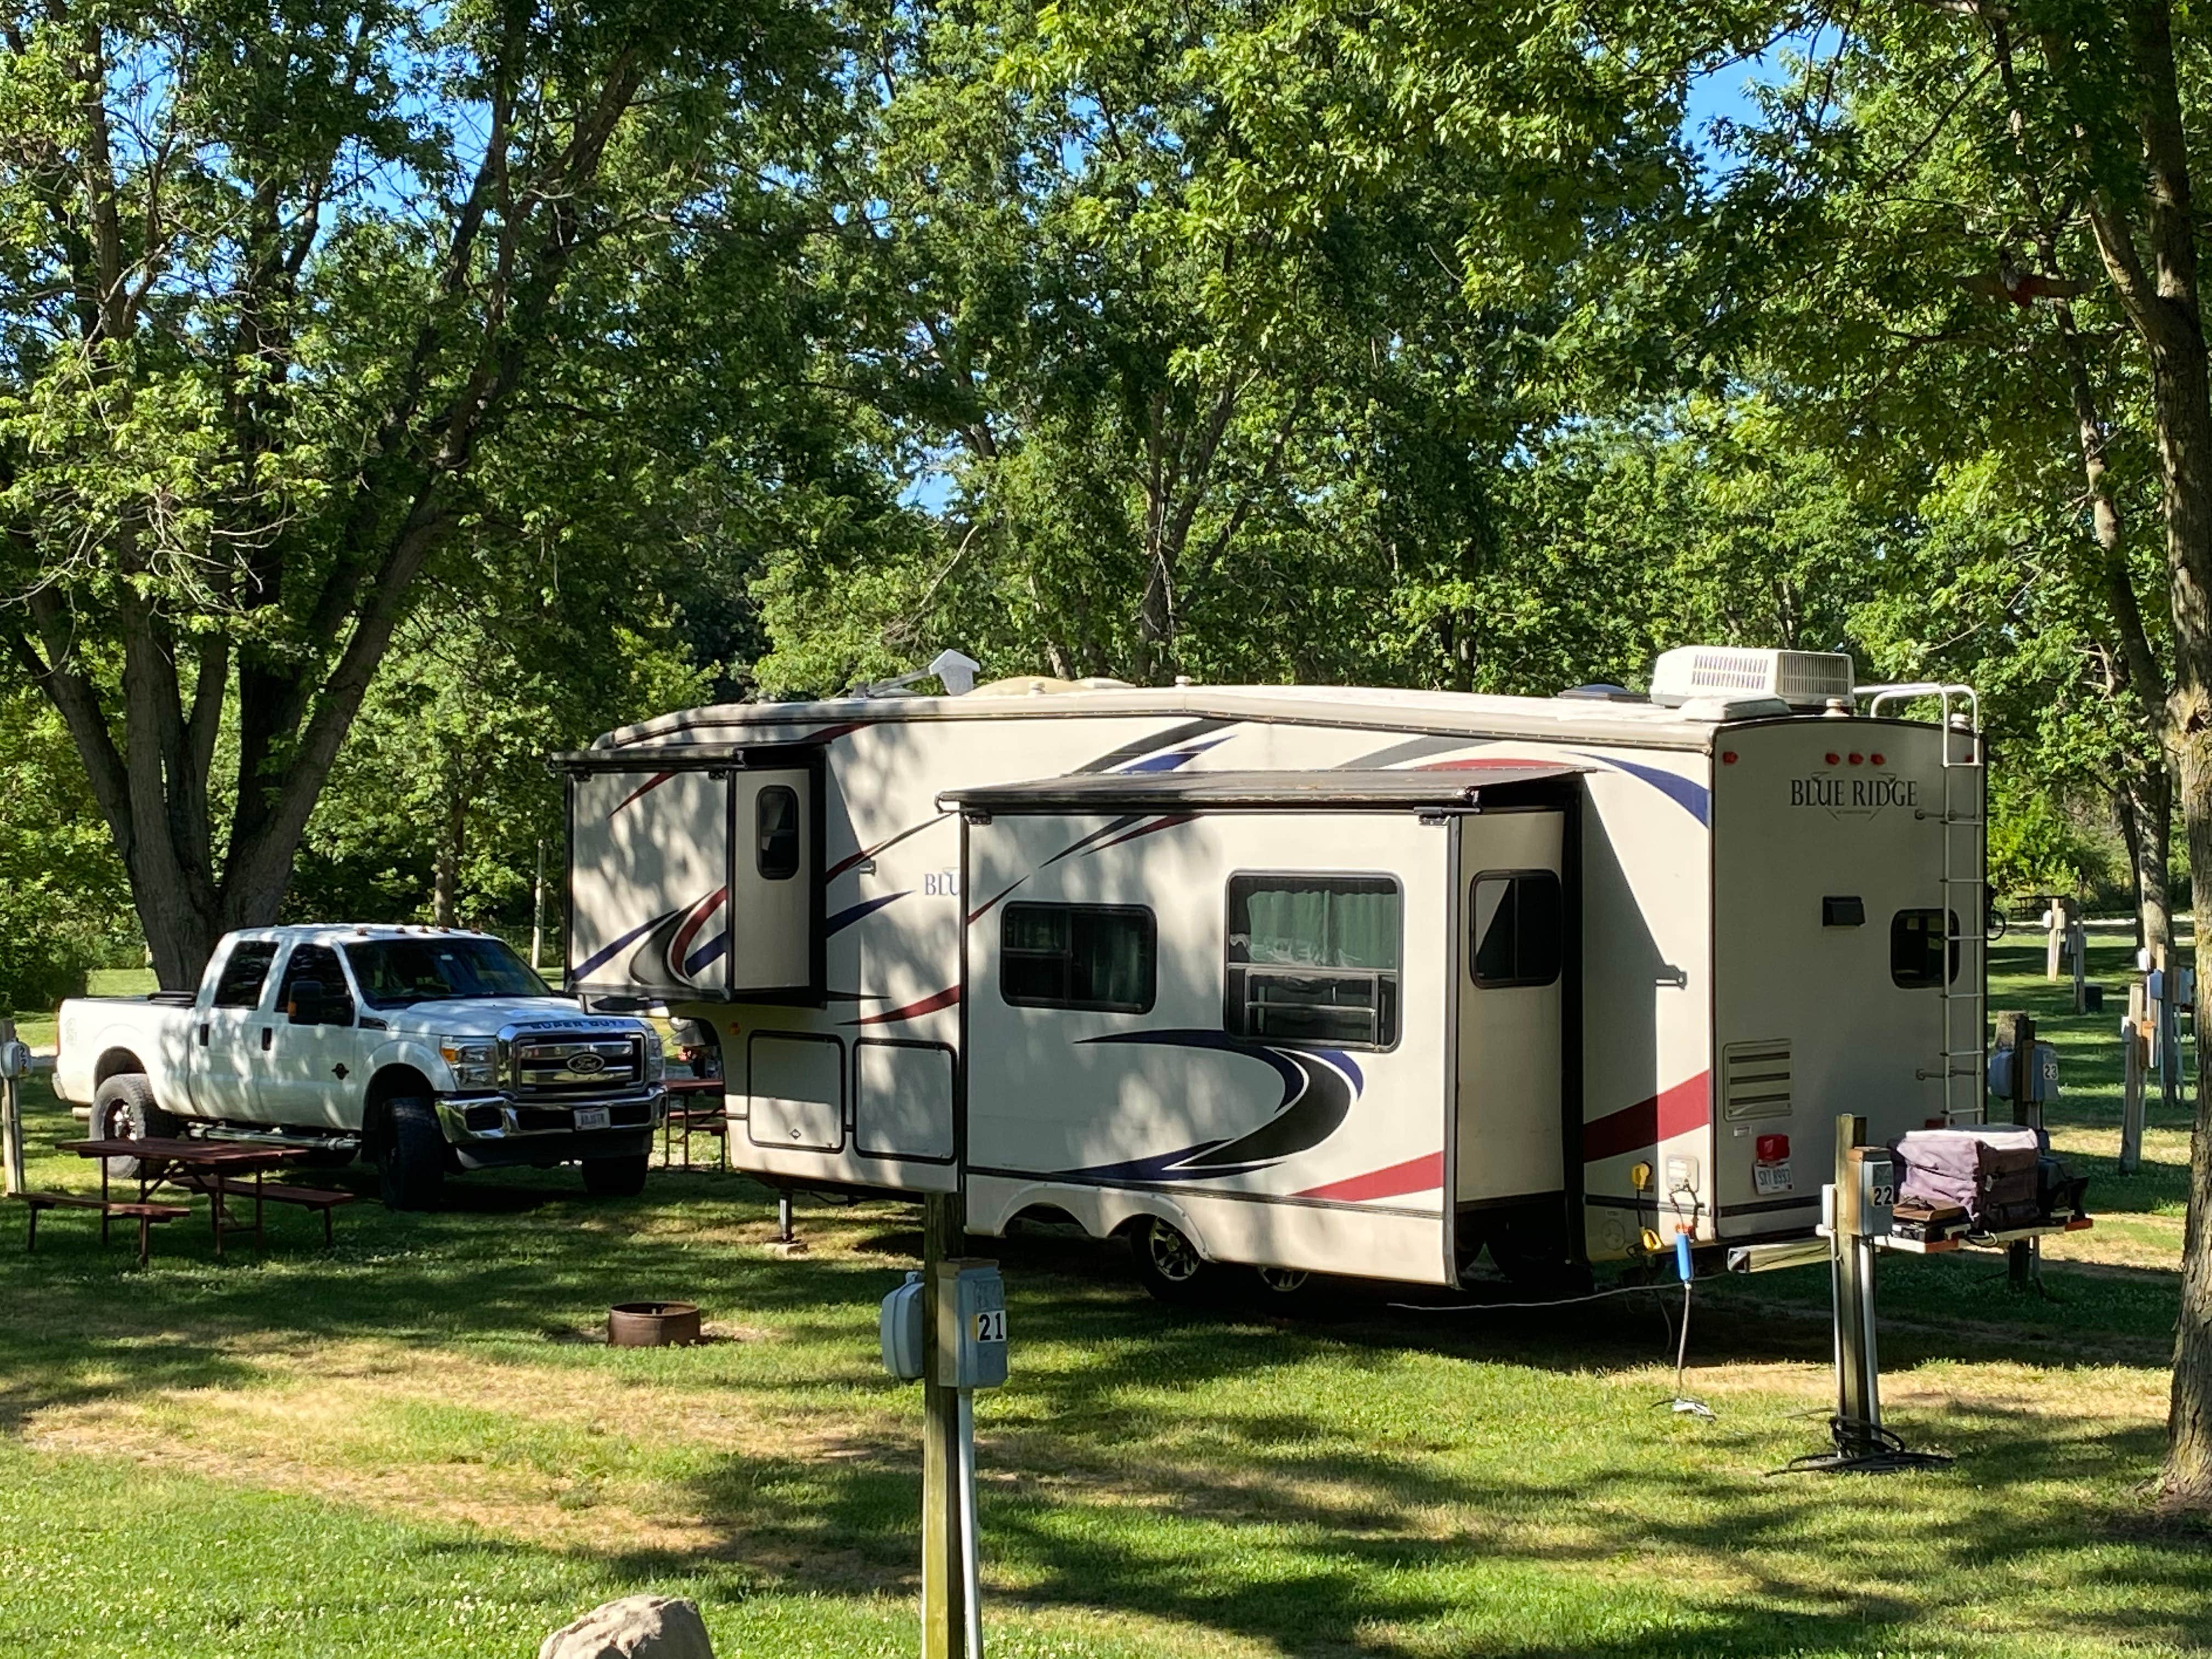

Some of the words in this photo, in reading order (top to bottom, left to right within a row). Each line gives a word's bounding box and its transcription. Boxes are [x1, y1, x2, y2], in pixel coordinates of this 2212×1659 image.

[1790, 779, 1845, 806] BLUE
[1852, 780, 1918, 807] RIDGE
[531, 1020, 584, 1029] SUPER
[2045, 1064, 2057, 1079] 23
[1874, 1186, 1892, 1206] 22
[979, 1312, 1003, 1341] 21
